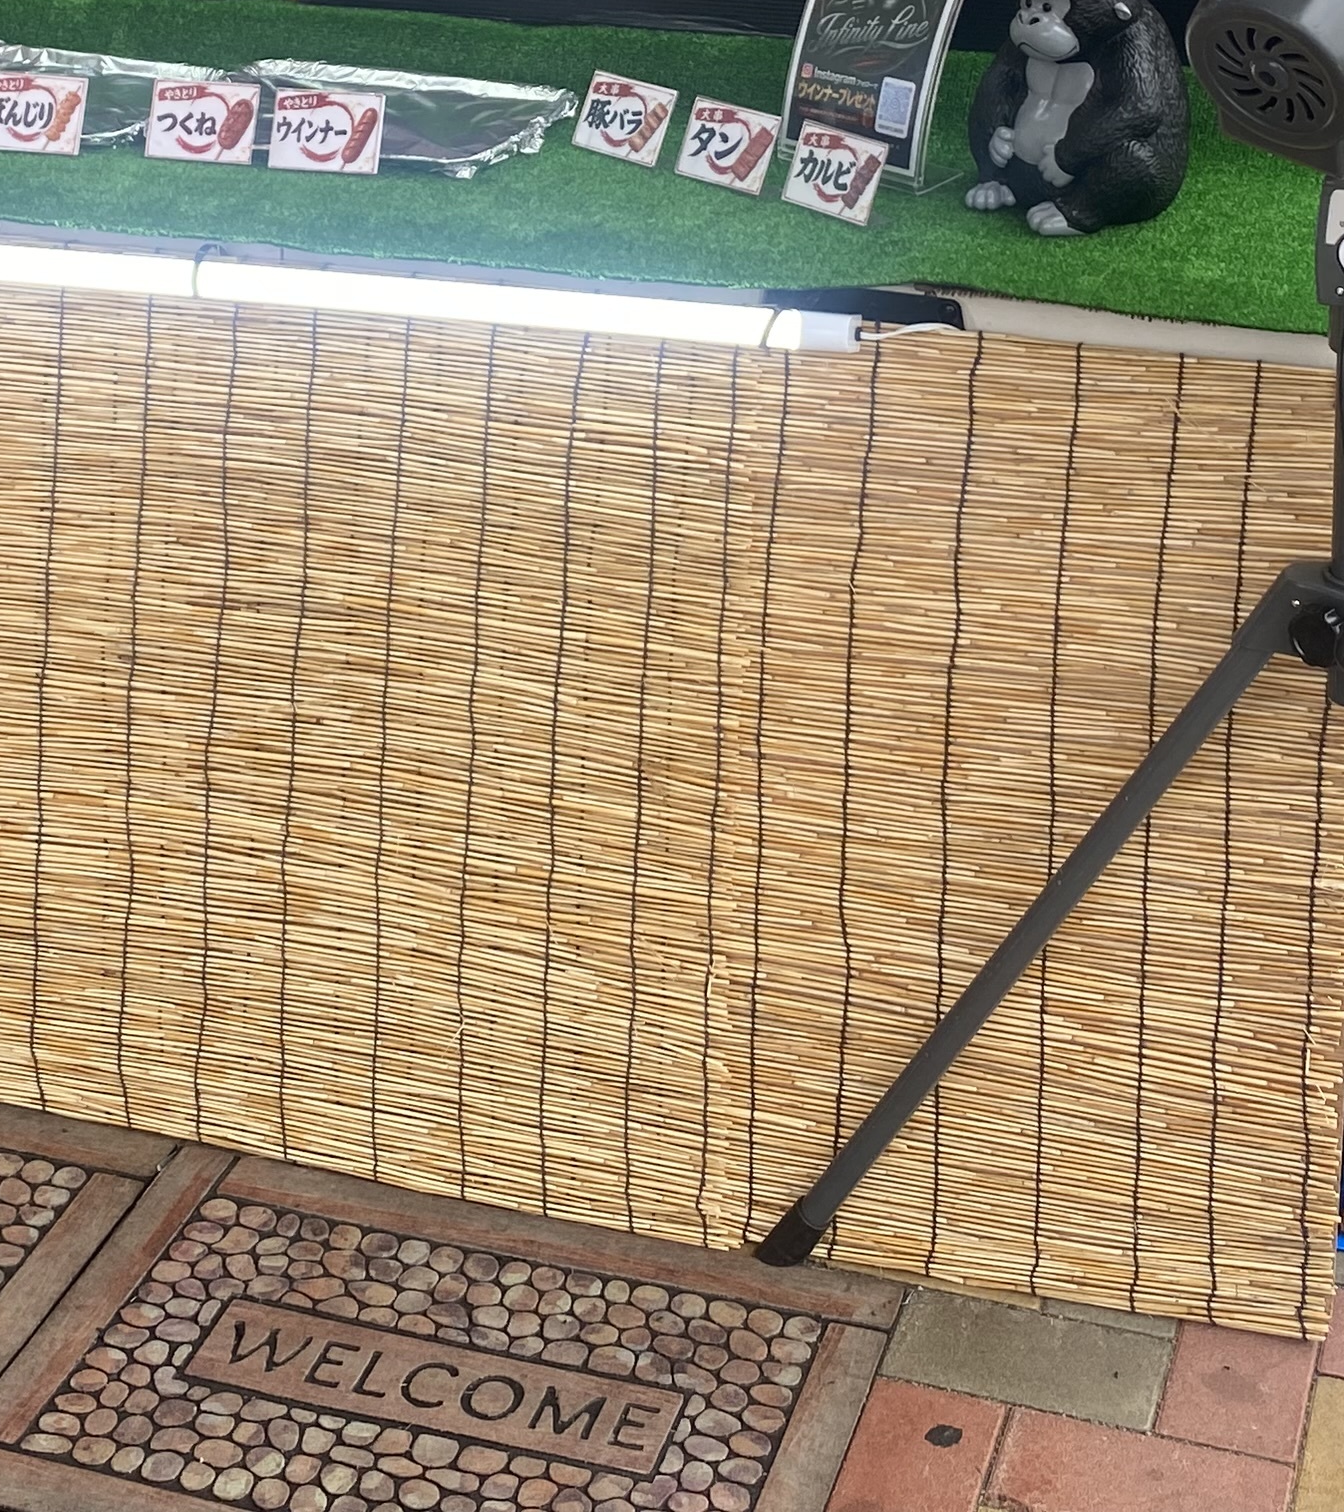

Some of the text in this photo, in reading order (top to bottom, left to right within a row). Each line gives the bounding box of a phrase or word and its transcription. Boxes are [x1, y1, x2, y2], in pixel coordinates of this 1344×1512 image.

[814, 66, 857, 86] Instagram
[163, 86, 198, 100] やきとり
[283, 95, 318, 109] やきとり
[156, 110, 218, 138] つくね
[275, 117, 349, 145] ウインナー
[583, 98, 644, 136] 豚バラ
[688, 123, 745, 161] タン
[793, 149, 858, 192] カルビ
[228, 1320, 661, 1453] WELCOME
